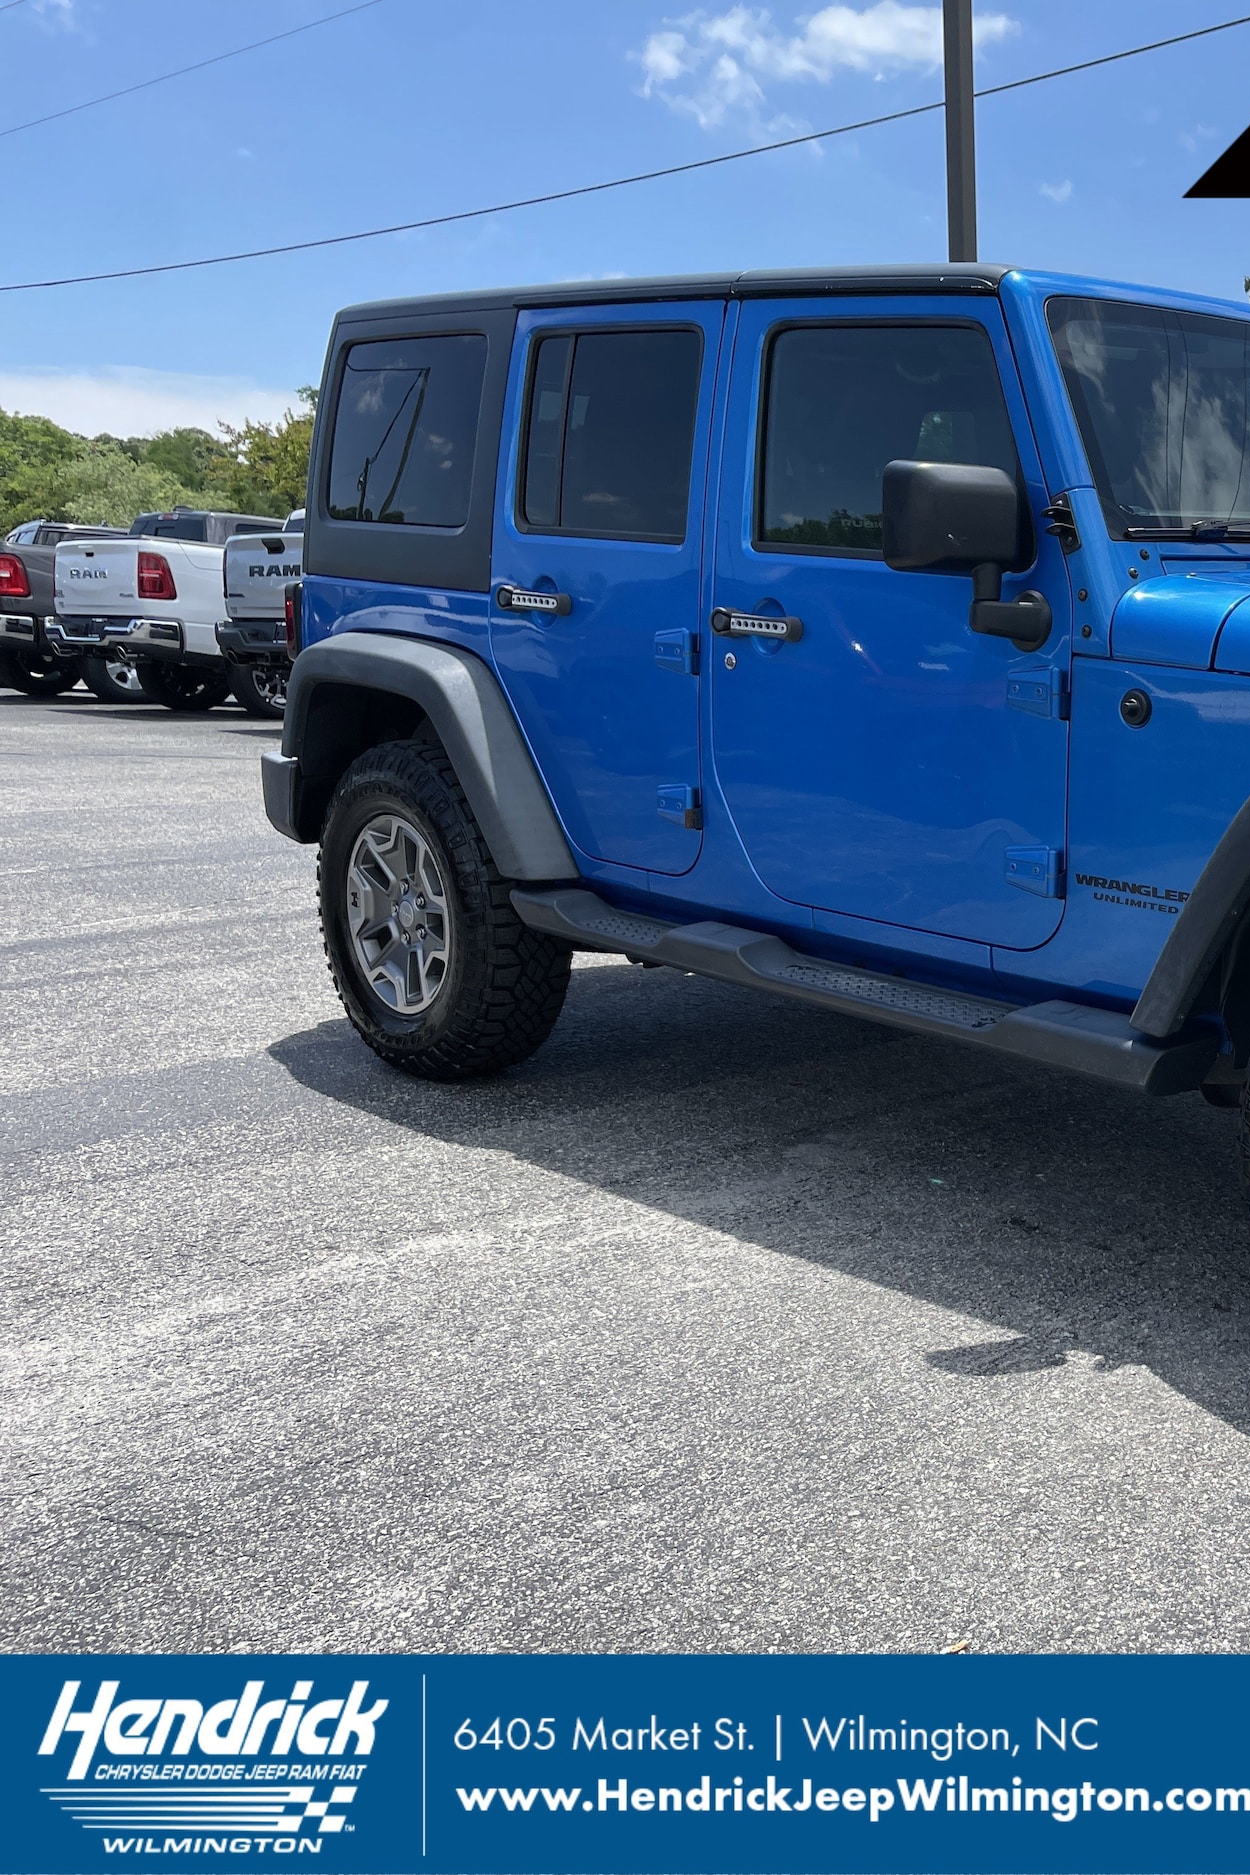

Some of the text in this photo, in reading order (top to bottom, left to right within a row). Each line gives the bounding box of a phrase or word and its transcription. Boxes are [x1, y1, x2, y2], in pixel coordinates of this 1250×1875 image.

[70, 568, 108, 580] RAM
[248, 564, 301, 577] RAM
[1075, 873, 1192, 903] WRANGLER
[1093, 892, 1179, 914] UNLIMITED
